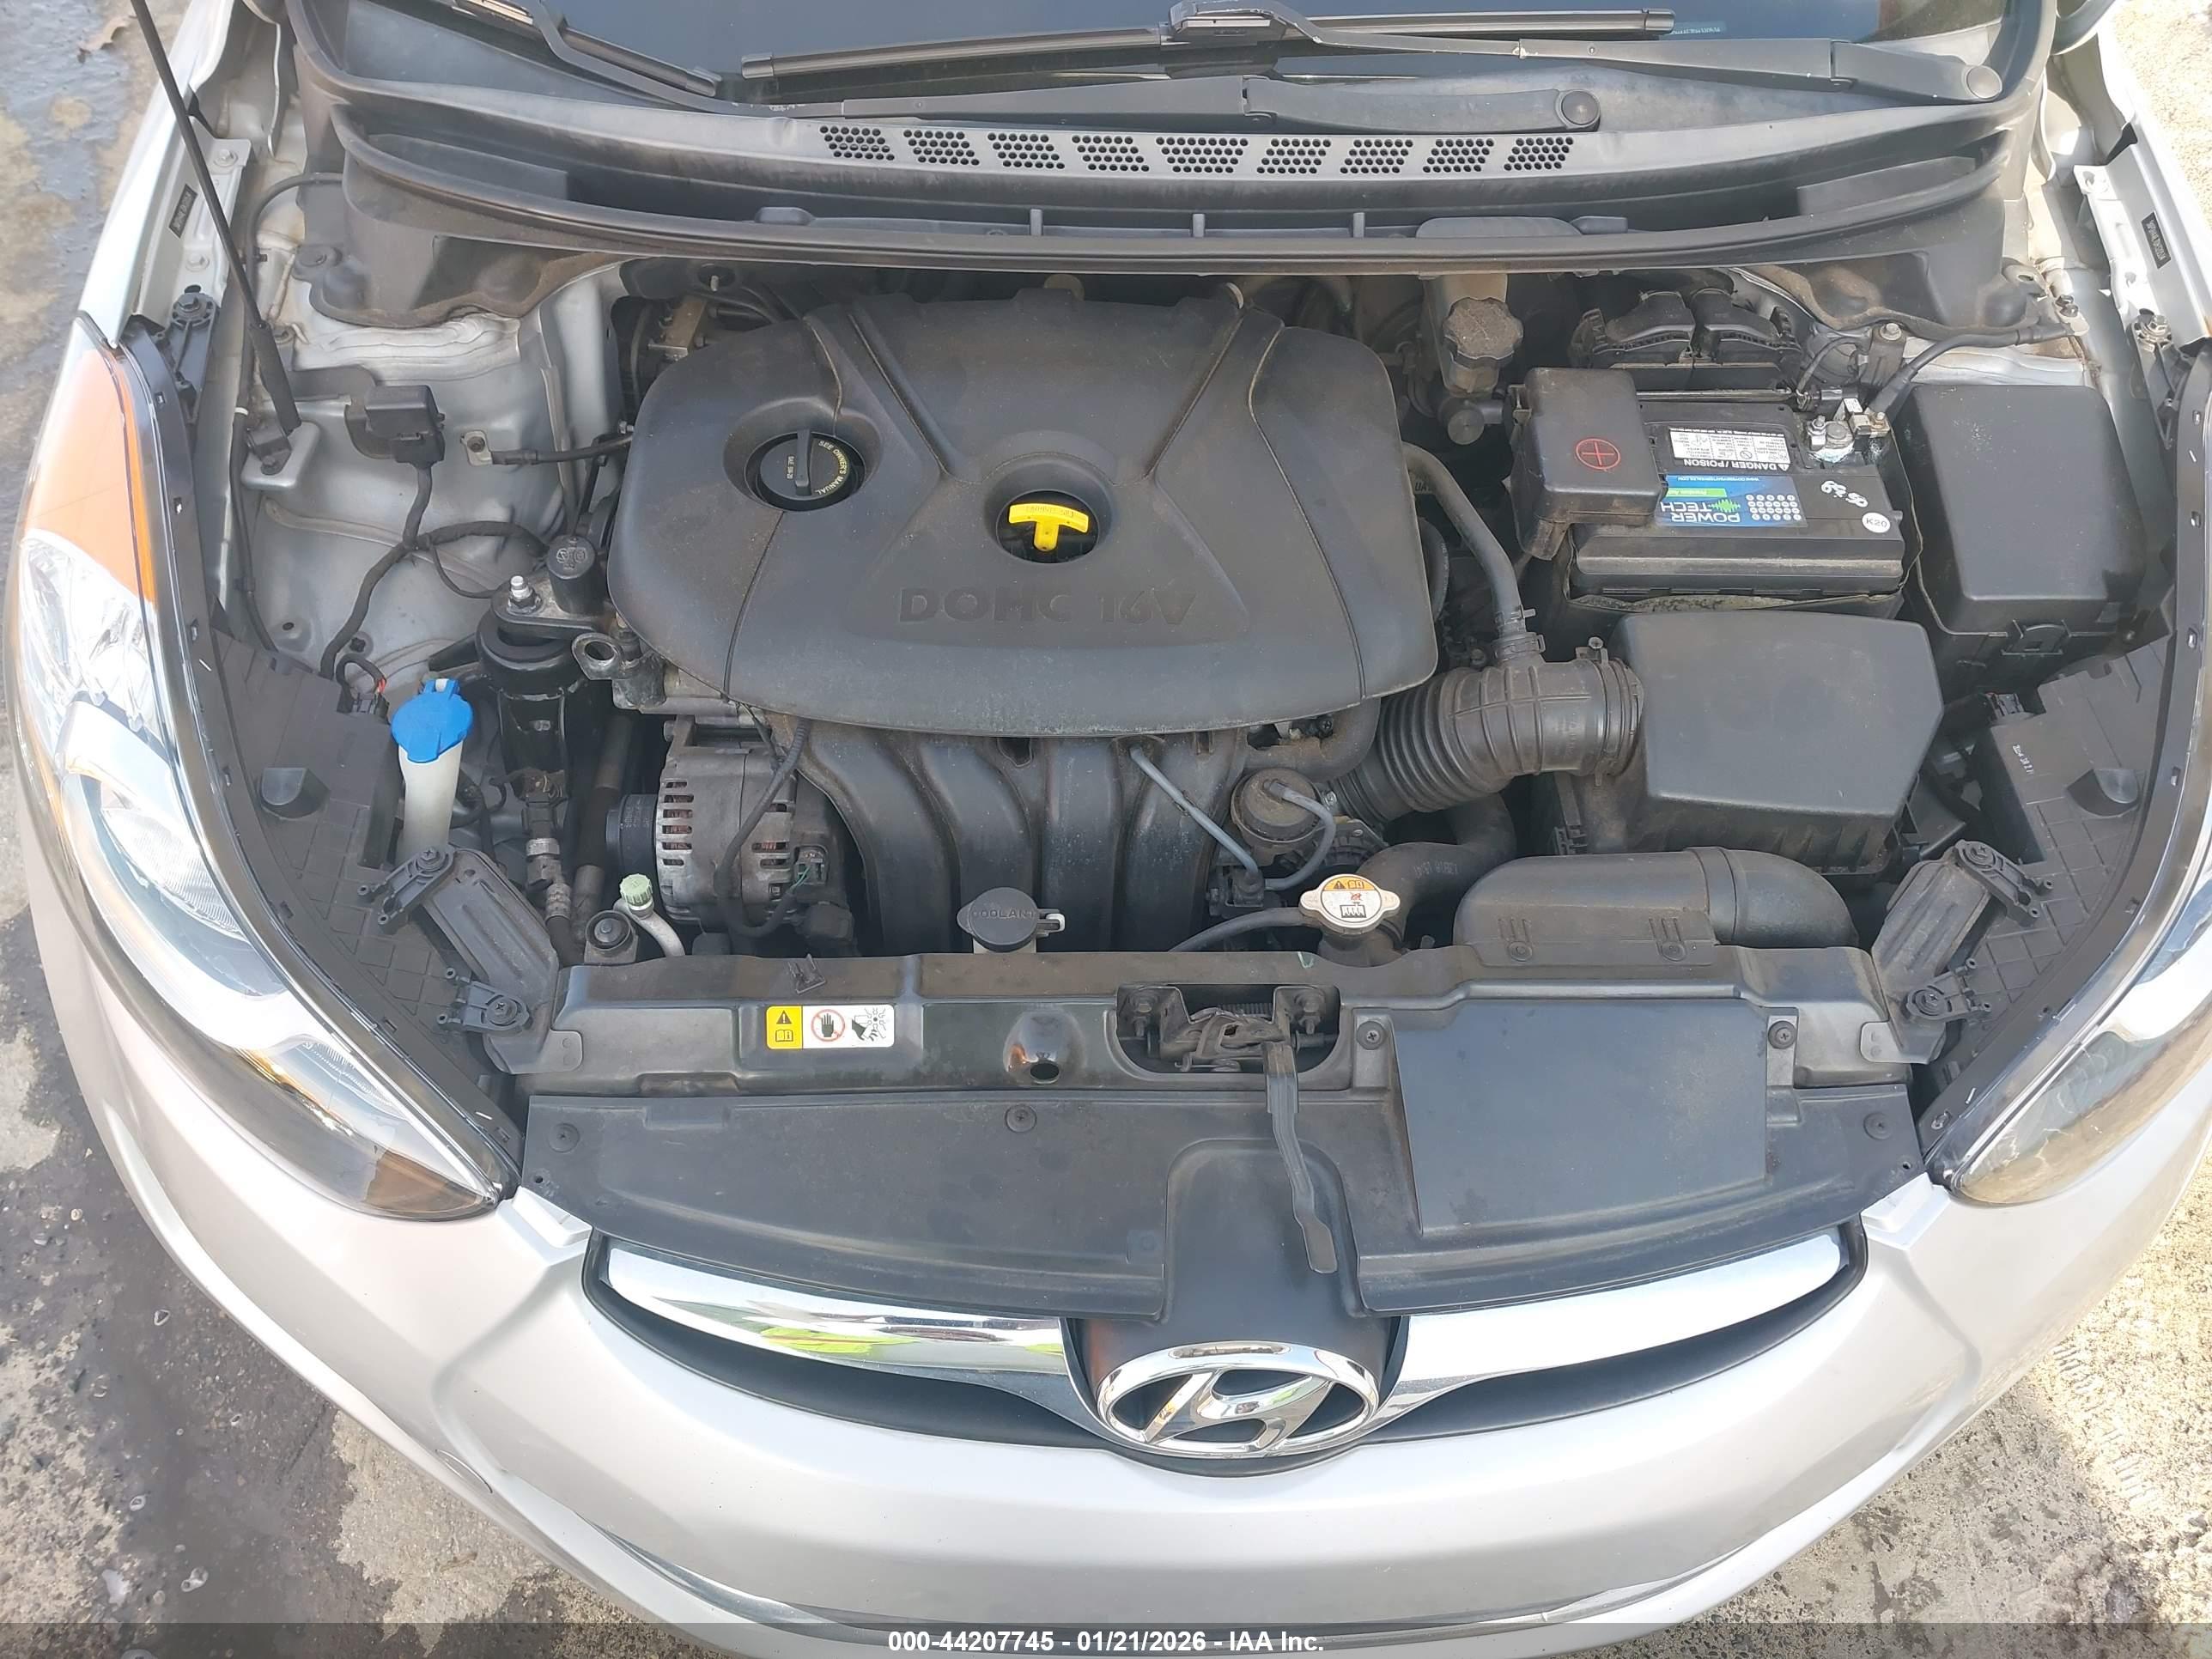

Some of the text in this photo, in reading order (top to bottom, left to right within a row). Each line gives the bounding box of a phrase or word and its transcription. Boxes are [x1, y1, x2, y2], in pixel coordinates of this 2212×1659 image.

[818, 441, 834, 450] SEE
[1683, 459, 1725, 467] POISON
[1731, 461, 1778, 471] DANGER
[815, 476, 843, 495] MANUAL
[1660, 501, 1712, 512] TECH
[1670, 512, 1741, 523] POWER
[1866, 517, 1887, 528] K20
[899, 587, 1196, 625] DOHC 16V
